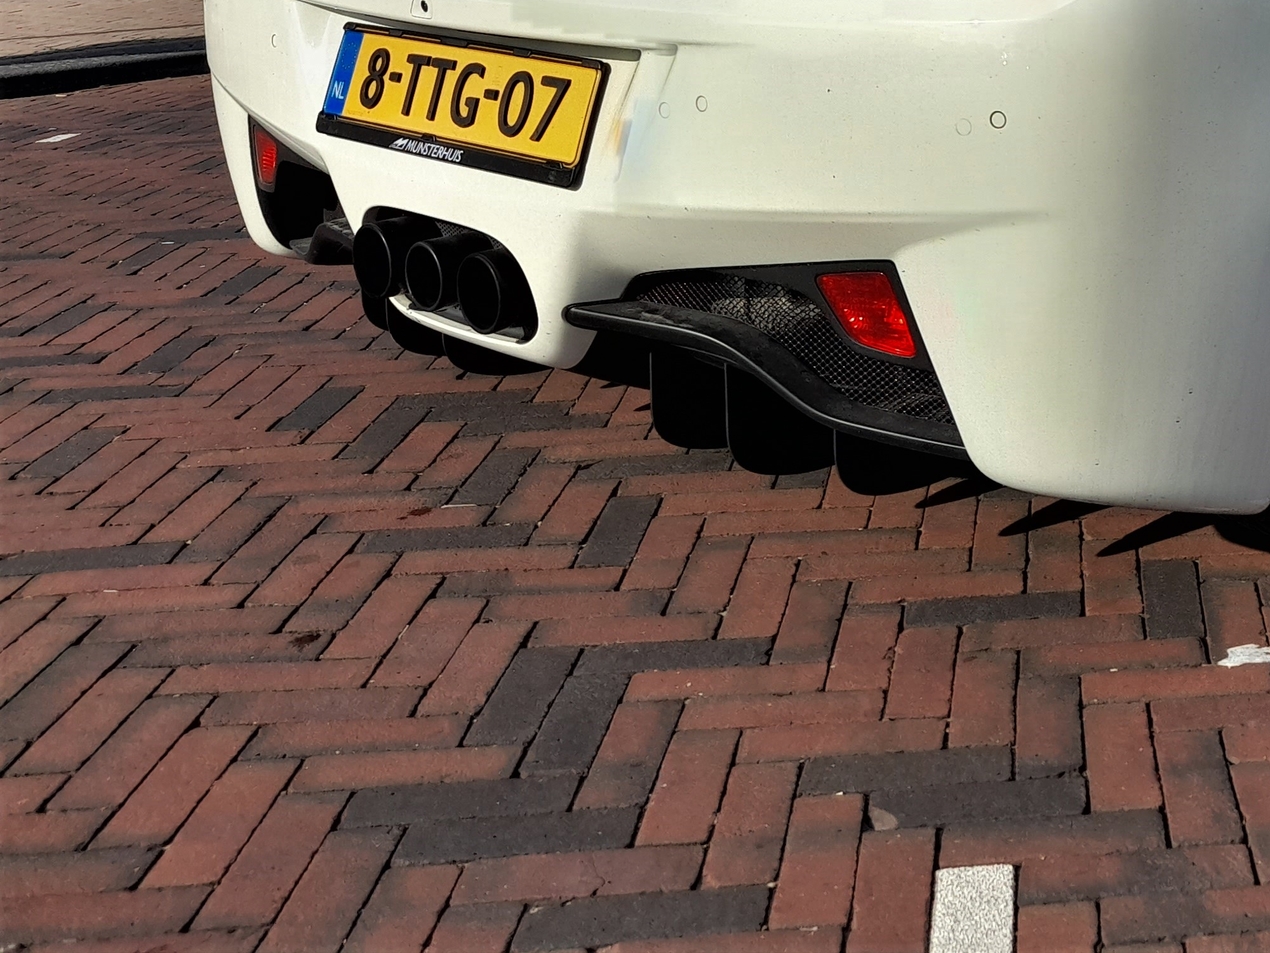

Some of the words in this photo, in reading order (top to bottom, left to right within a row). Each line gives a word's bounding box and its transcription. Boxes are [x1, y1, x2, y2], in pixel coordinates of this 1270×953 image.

[331, 79, 344, 100] NL
[359, 47, 572, 142] 8-TTG-07
[406, 140, 464, 162] MUNSTERHUIS
